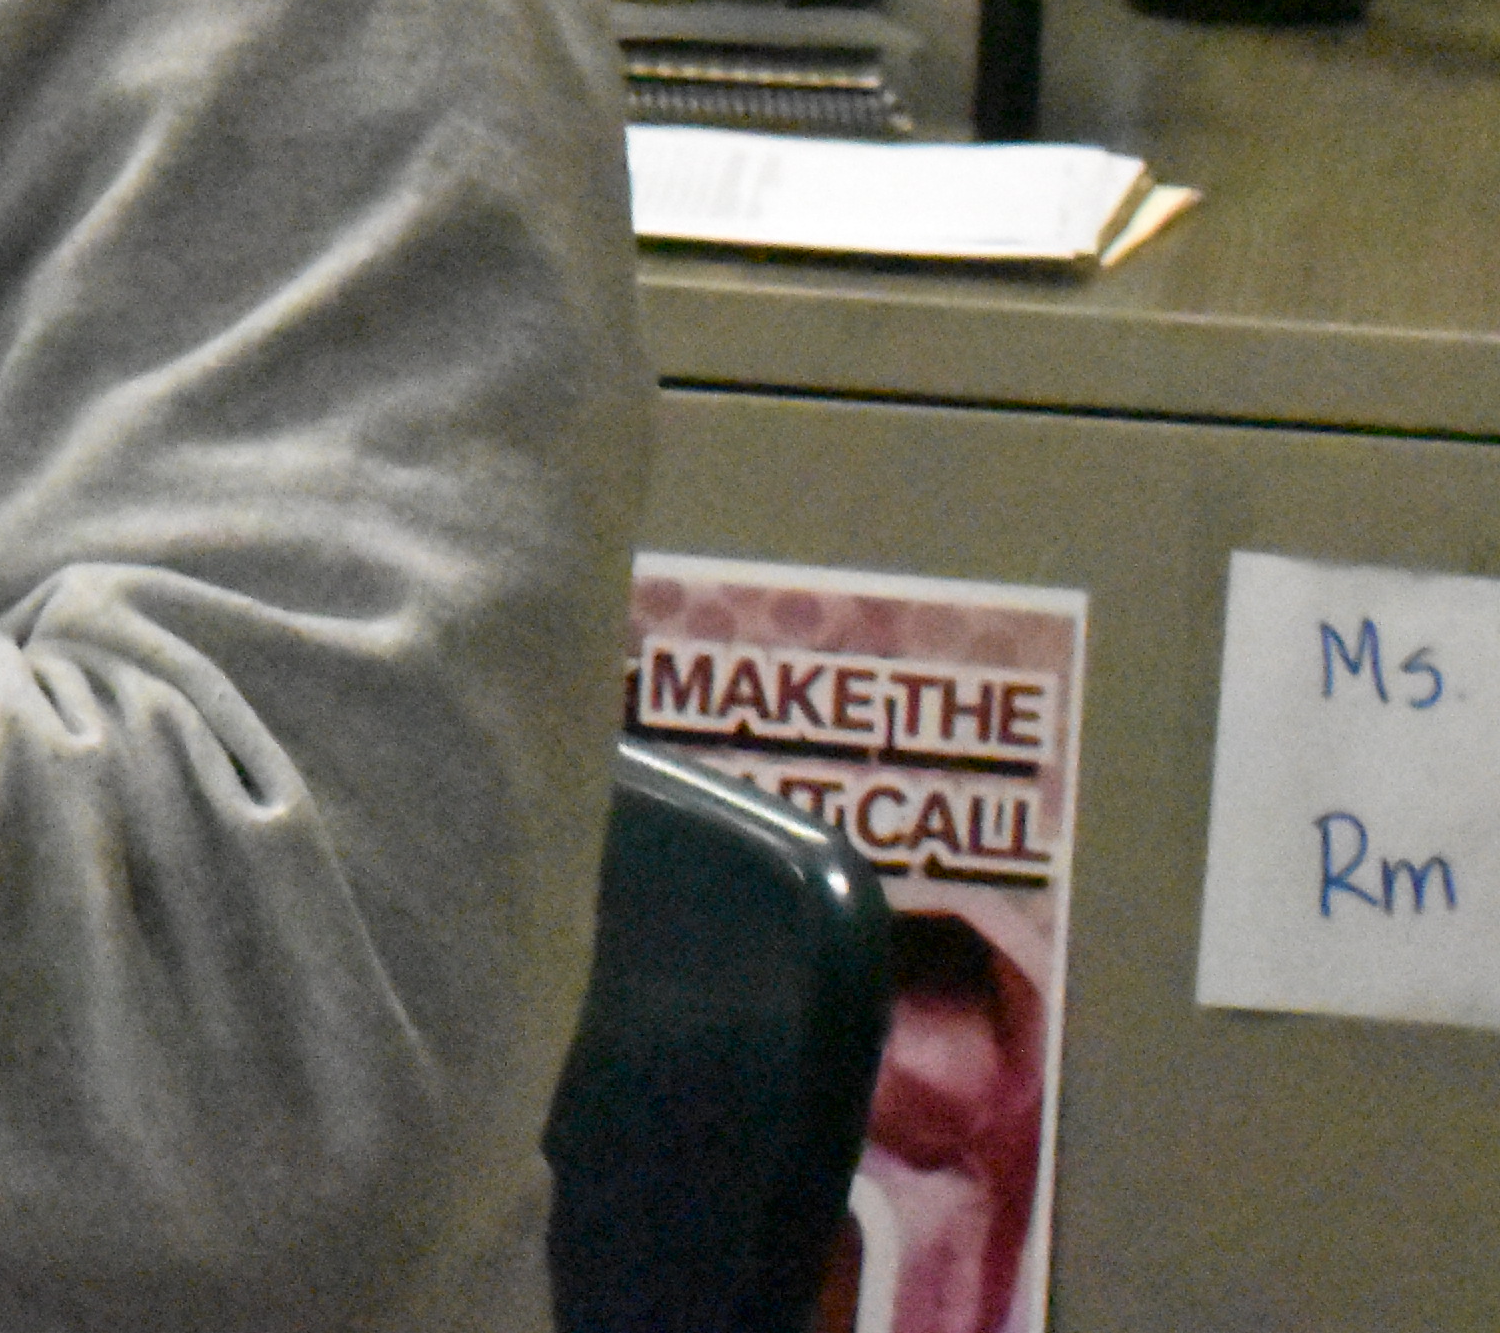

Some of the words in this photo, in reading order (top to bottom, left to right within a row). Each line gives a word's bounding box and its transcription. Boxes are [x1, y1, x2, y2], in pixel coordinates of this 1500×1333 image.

[650, 647, 876, 731] MAKE
[891, 671, 1043, 747] THE
[855, 786, 1051, 863] CALL
[1312, 810, 1458, 918] Rm
